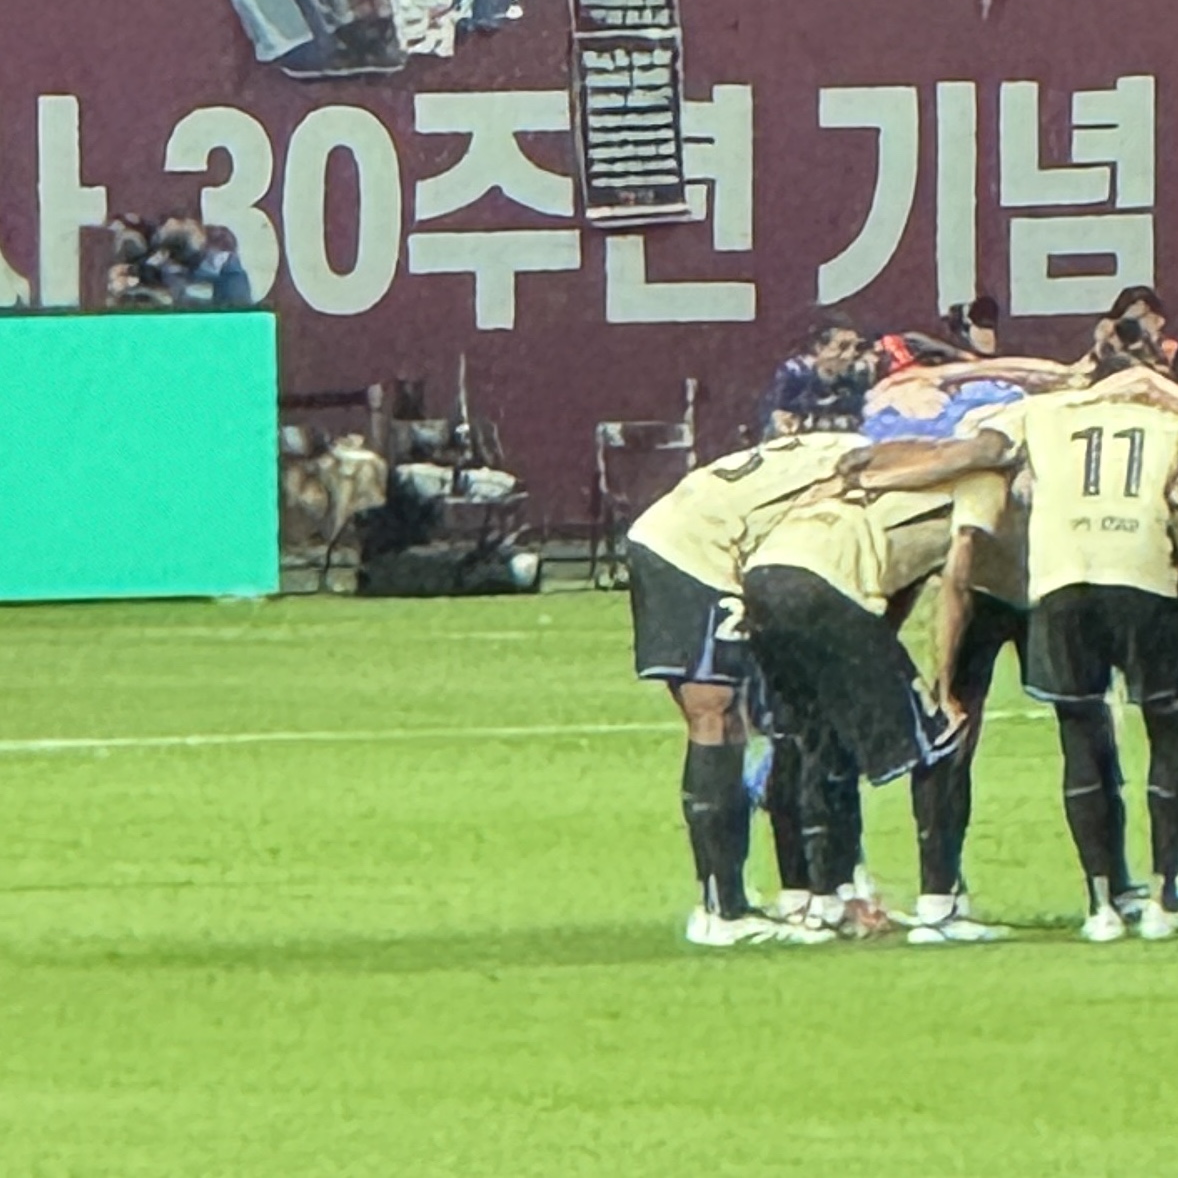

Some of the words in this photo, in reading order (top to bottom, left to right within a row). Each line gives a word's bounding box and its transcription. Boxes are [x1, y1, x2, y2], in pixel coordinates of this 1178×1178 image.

[164, 84, 756, 330] 30주년
[818, 75, 1155, 317] 기념
[1071, 426, 1145, 498] 11
